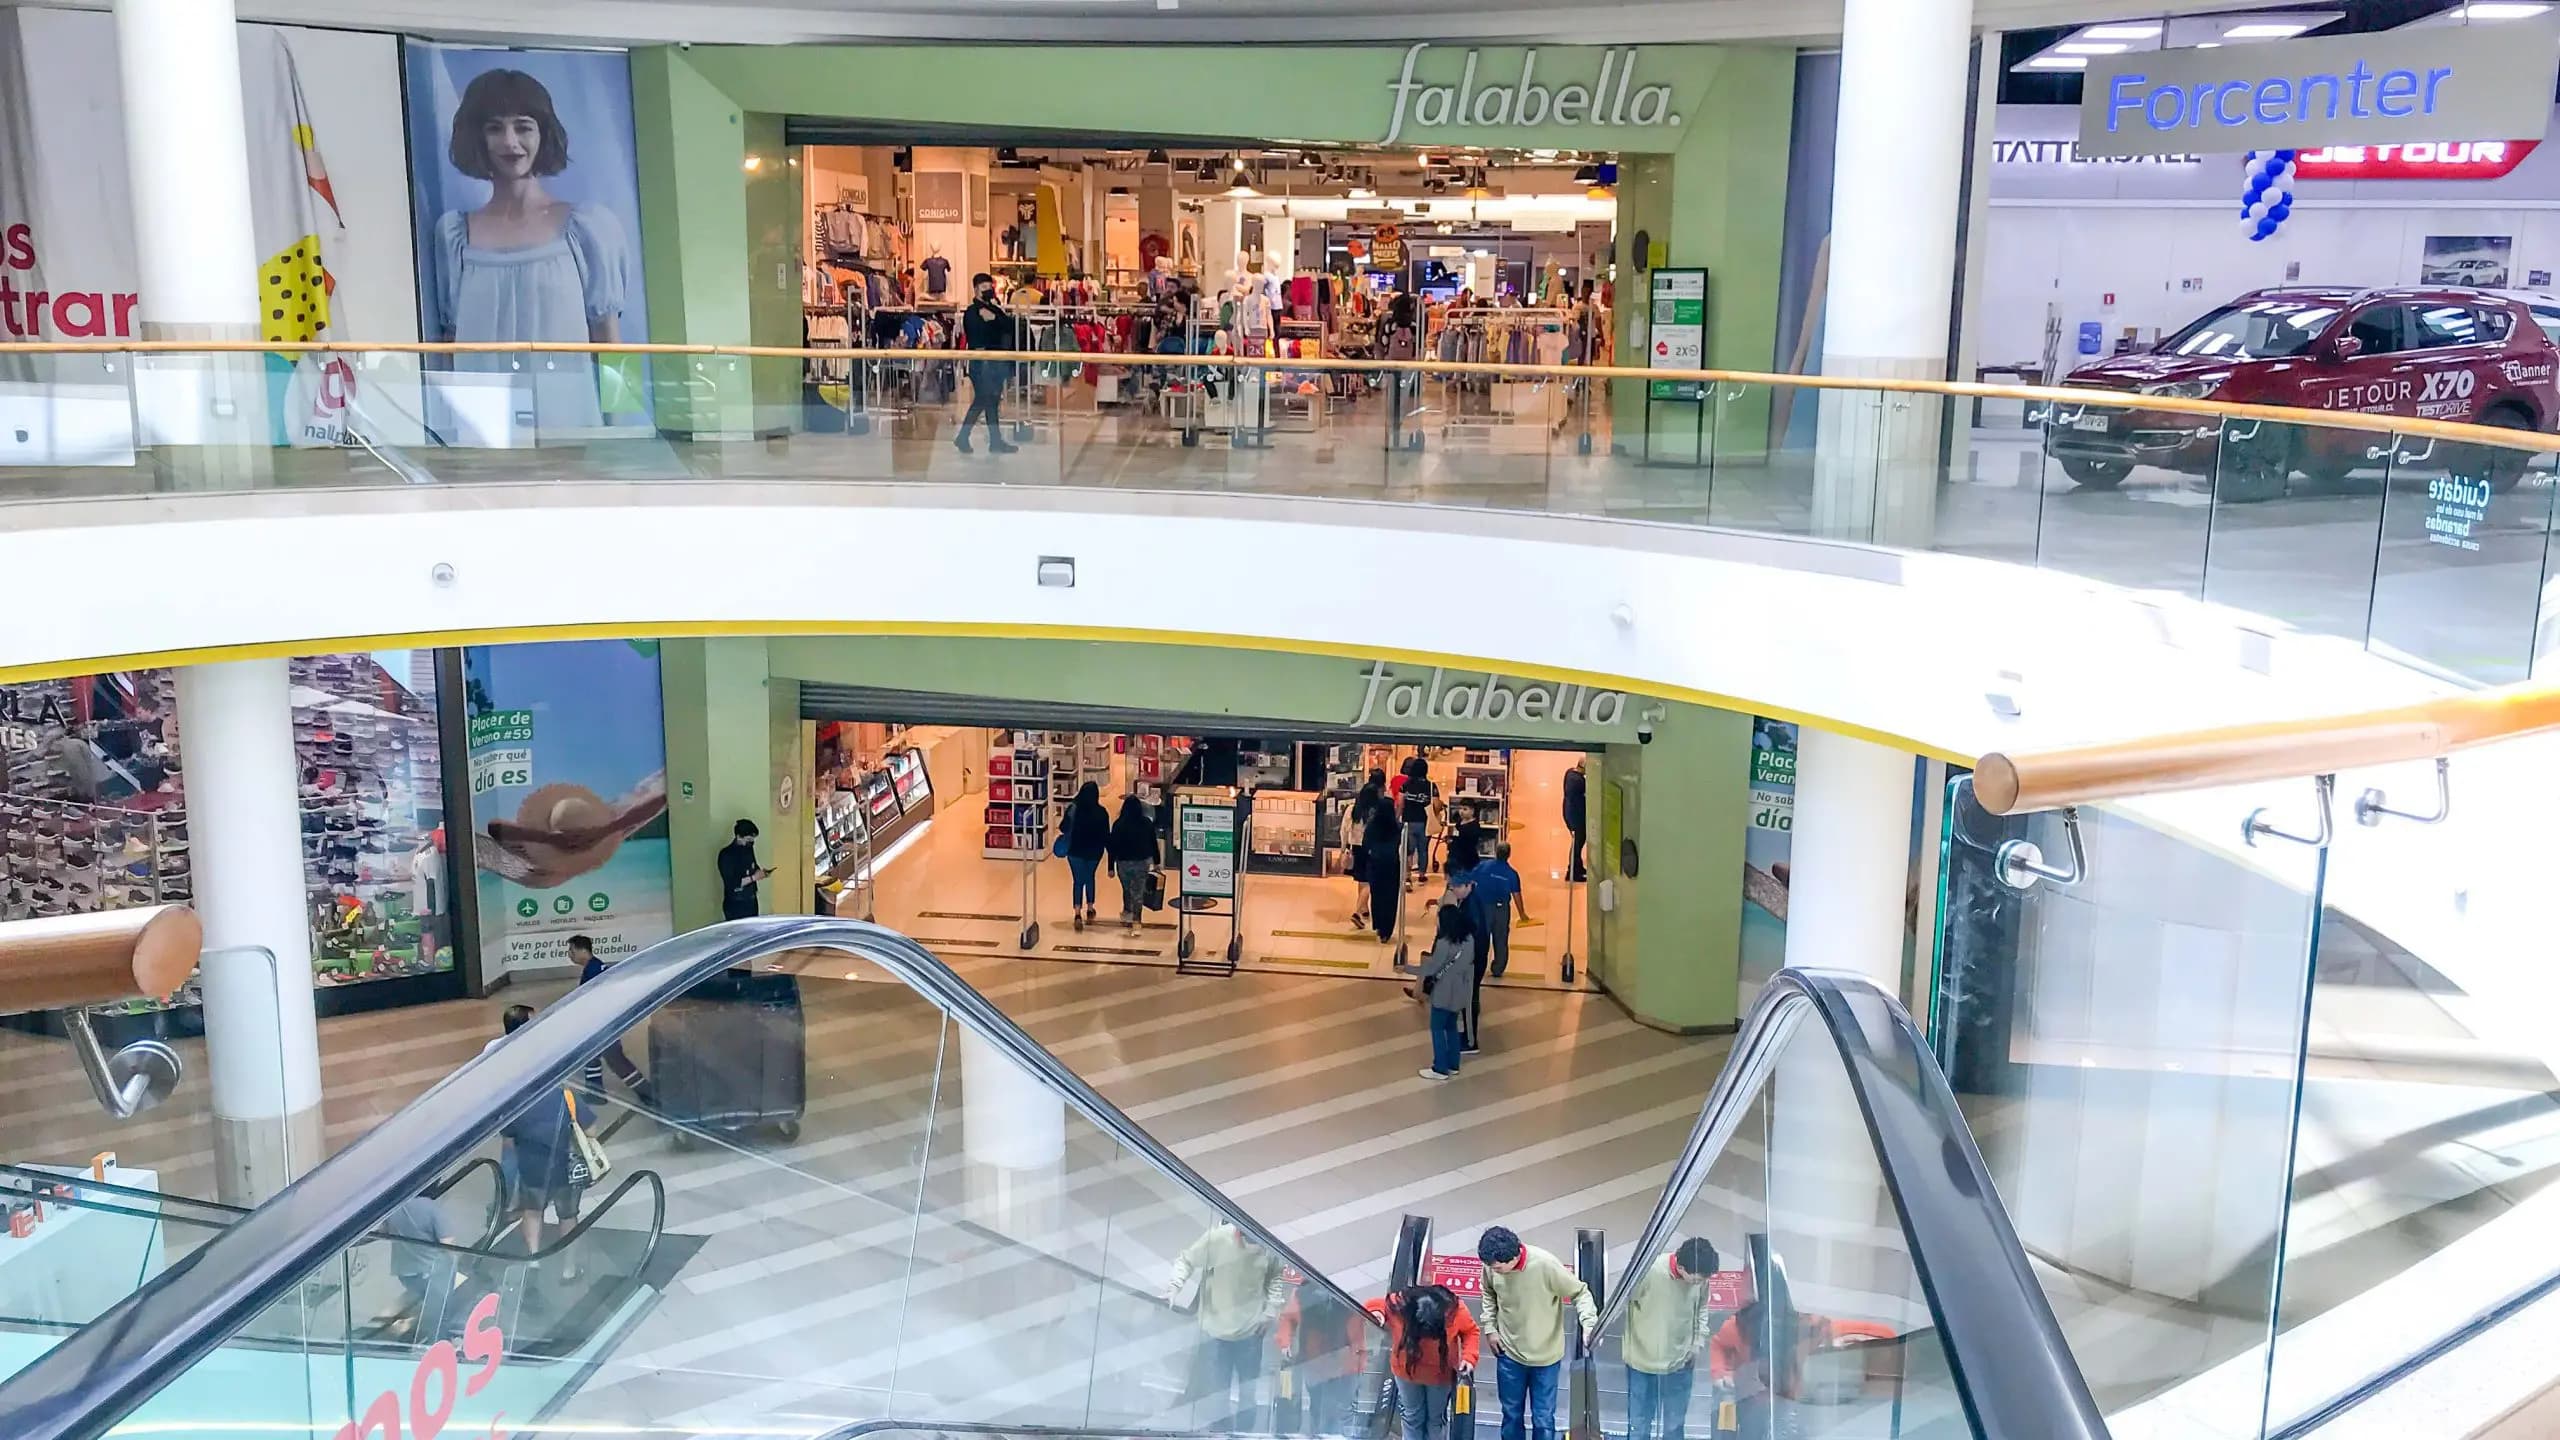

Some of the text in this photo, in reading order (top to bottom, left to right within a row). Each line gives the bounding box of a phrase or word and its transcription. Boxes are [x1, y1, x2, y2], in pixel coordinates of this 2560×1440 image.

[2108, 59, 2452, 132] Forcenter
[2300, 142, 2505, 163] JETOUR
[0, 223, 36, 270] s
[2323, 381, 2411, 408] JETOUR
[472, 711, 530, 733] Placer de
[472, 728, 531, 748] Verano #59
[506, 749, 527, 763] qué
[1758, 752, 1797, 769] Plac
[475, 768, 528, 792] día es
[1756, 792, 1772, 802] No
[511, 941, 532, 951] Ven
[535, 940, 554, 951] por
[522, 952, 529, 960] 2
[533, 950, 547, 960] de
